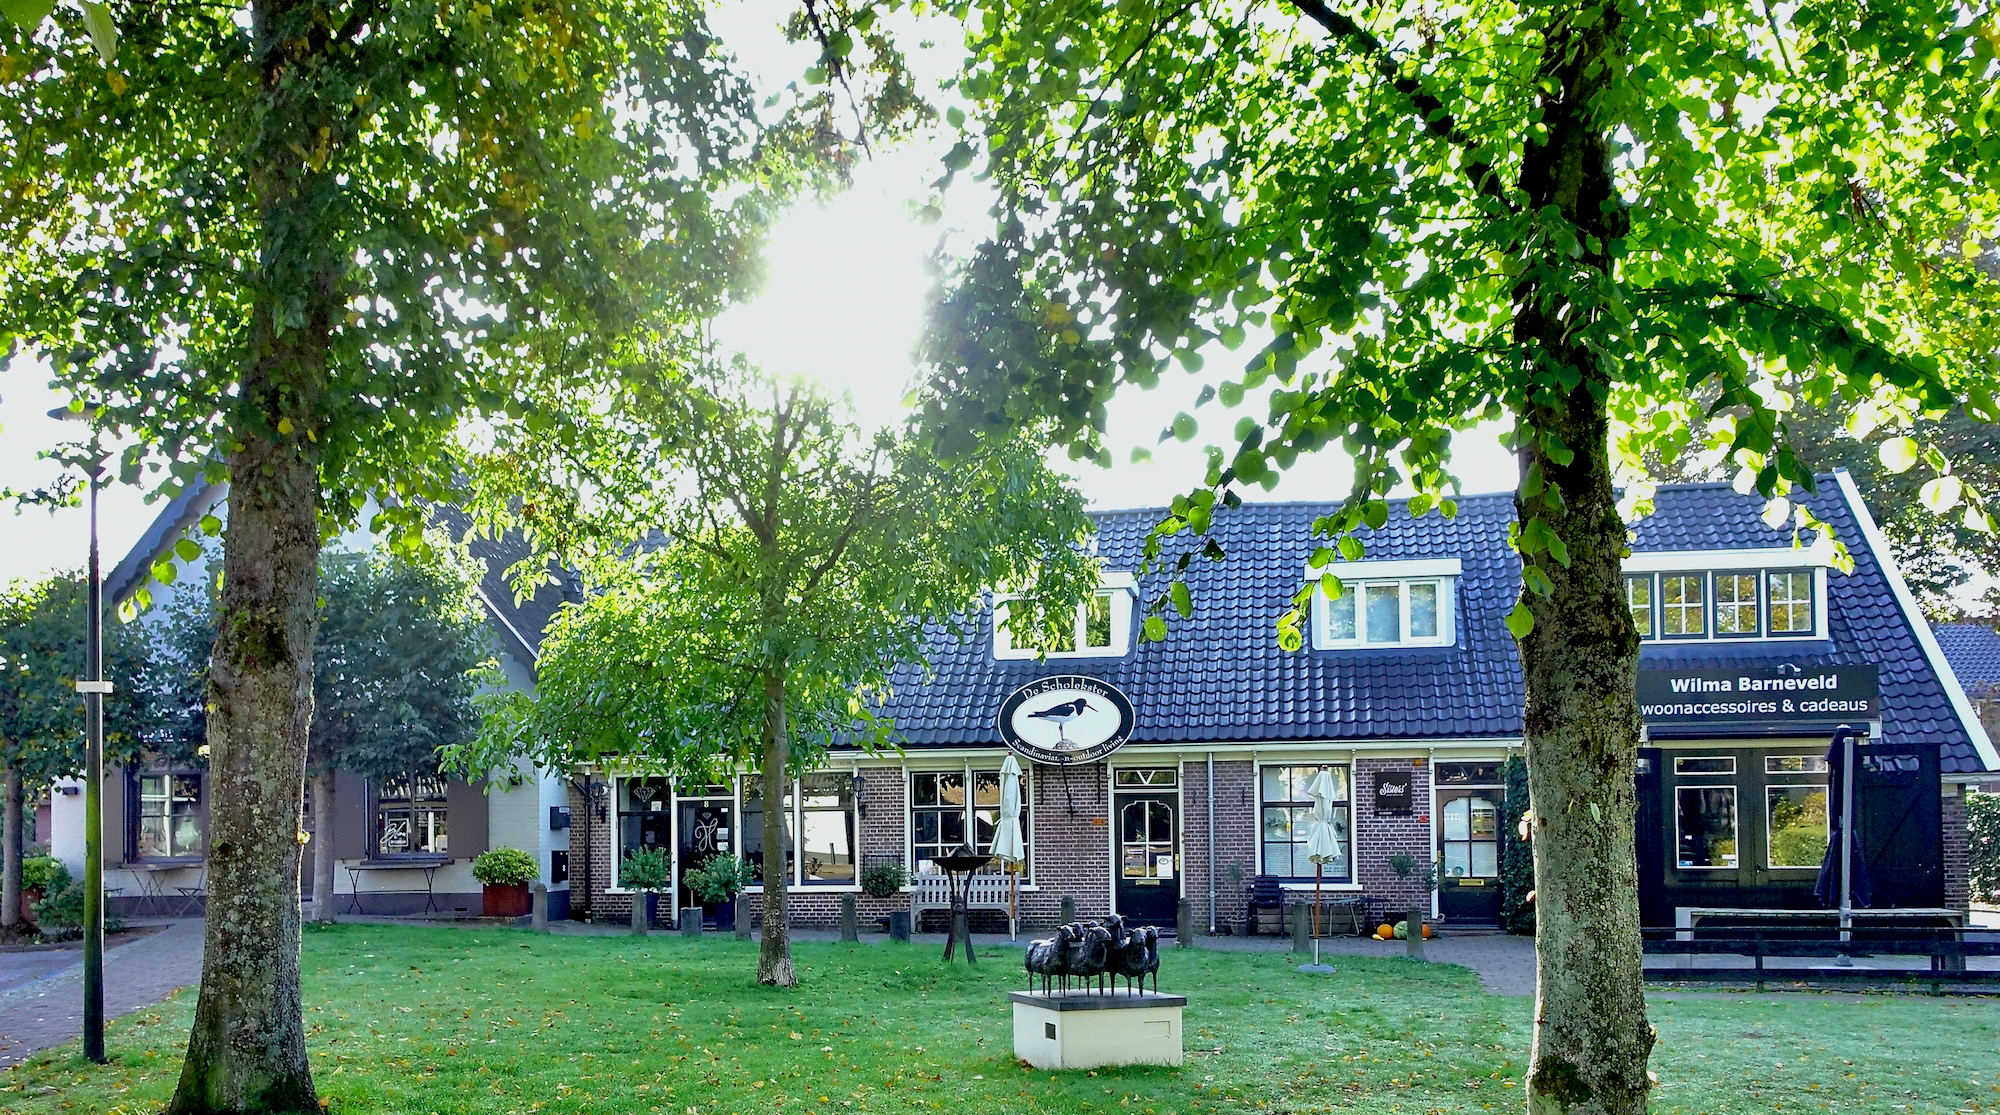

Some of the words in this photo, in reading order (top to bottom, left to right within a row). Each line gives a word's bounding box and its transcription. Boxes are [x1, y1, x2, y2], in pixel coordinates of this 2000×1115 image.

[1021, 687, 1041, 700] De
[1041, 677, 1109, 697] Scholekster
[1670, 678, 1732, 693] Wilma
[1738, 674, 1838, 692] Barneveld
[1641, 699, 1777, 716] woonaccessoires
[1782, 699, 1795, 713] &
[1799, 697, 1868, 713] cadeaus
[1102, 735, 1124, 753] living
